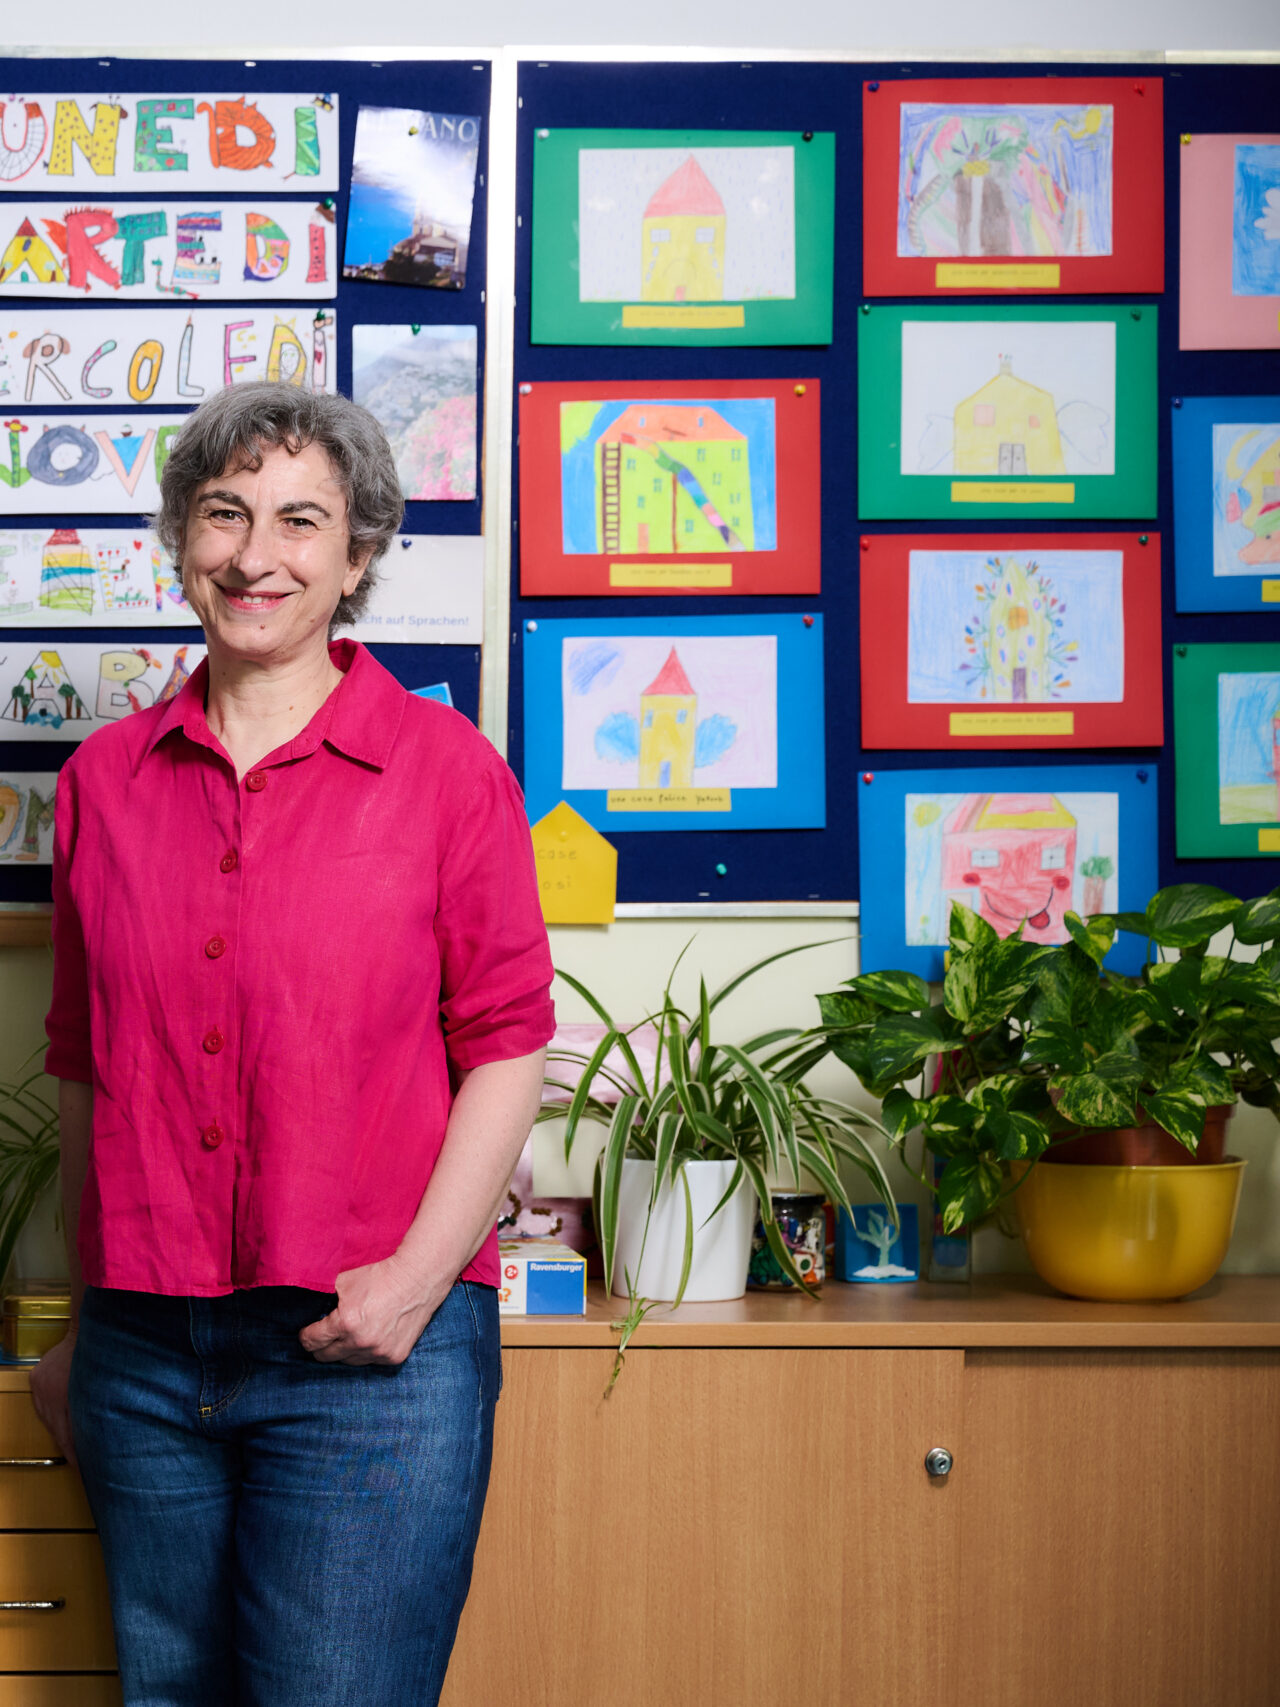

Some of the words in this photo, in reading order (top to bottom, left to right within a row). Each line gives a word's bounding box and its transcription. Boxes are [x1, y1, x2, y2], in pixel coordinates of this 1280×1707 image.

[424, 115, 477, 143] ANO
[386, 614, 405, 625] auf
[408, 615, 469, 627] Sprachen!
[530, 1263, 583, 1273] Ravensburger
